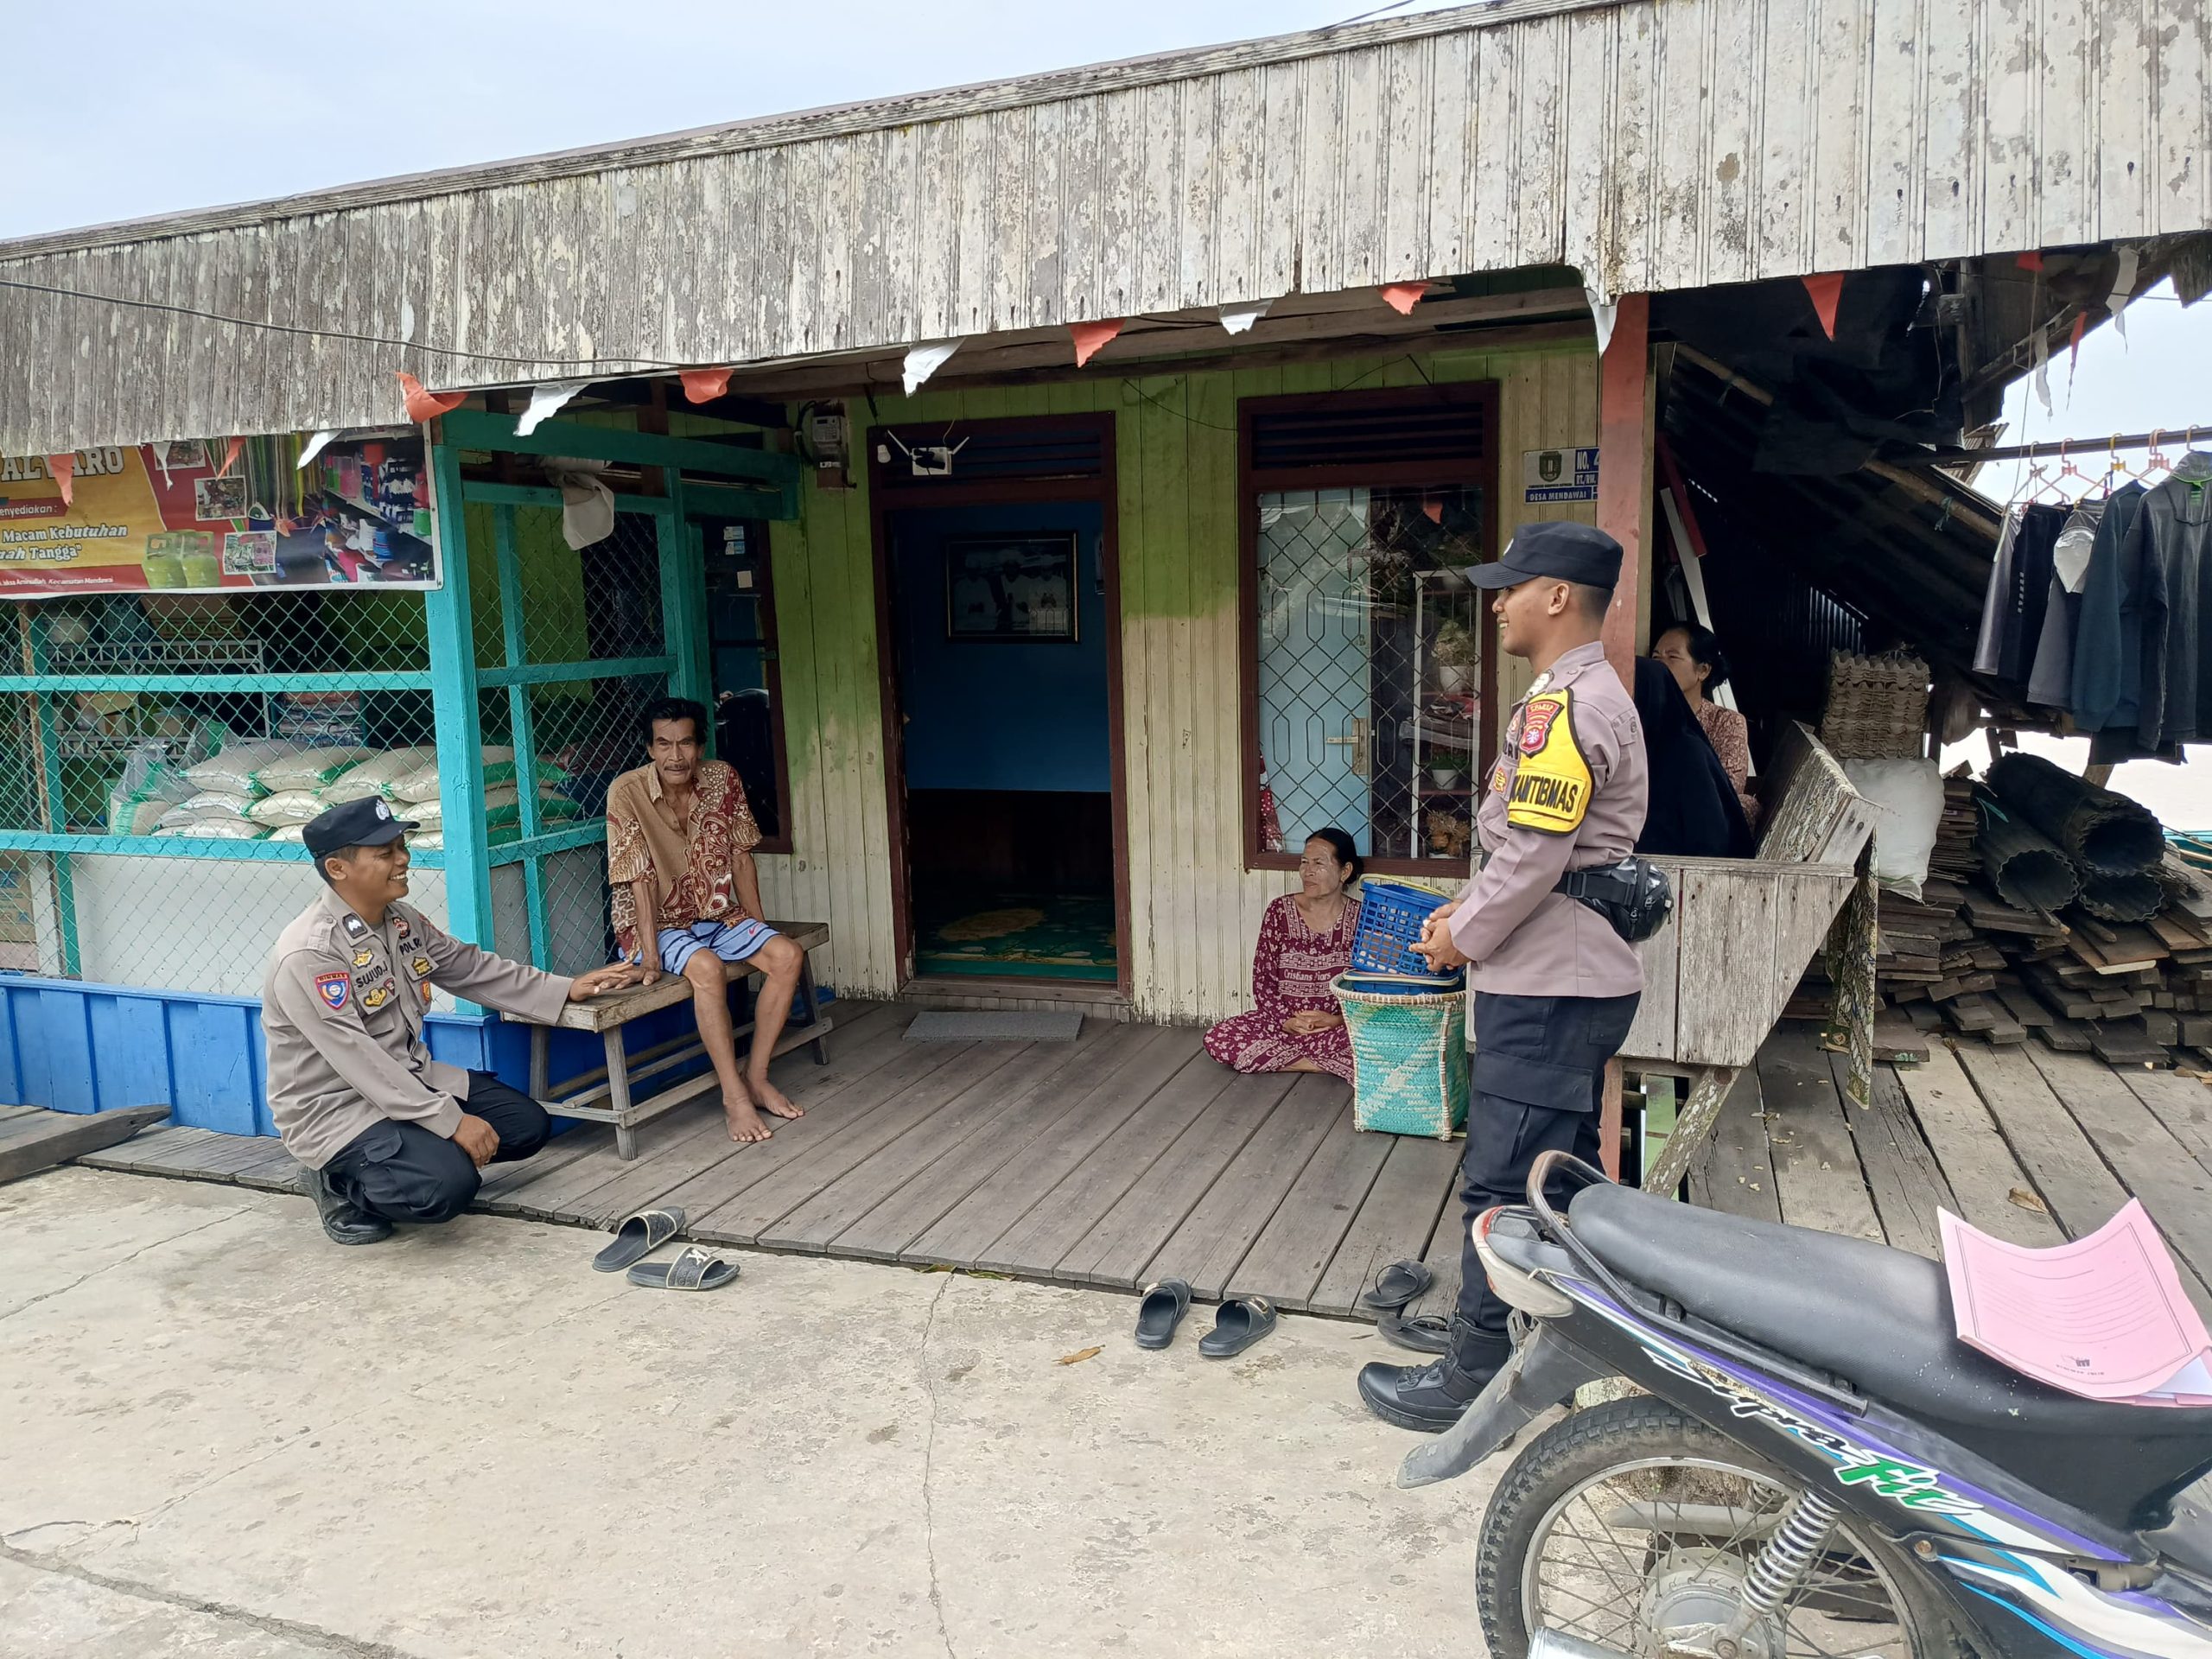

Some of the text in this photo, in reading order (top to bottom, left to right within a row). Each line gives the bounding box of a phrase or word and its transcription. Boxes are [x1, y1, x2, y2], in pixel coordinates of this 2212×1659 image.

[1529, 491, 1586, 501] DESA MENDAWAI
[2, 523, 128, 543] Macam Kebutuhan
